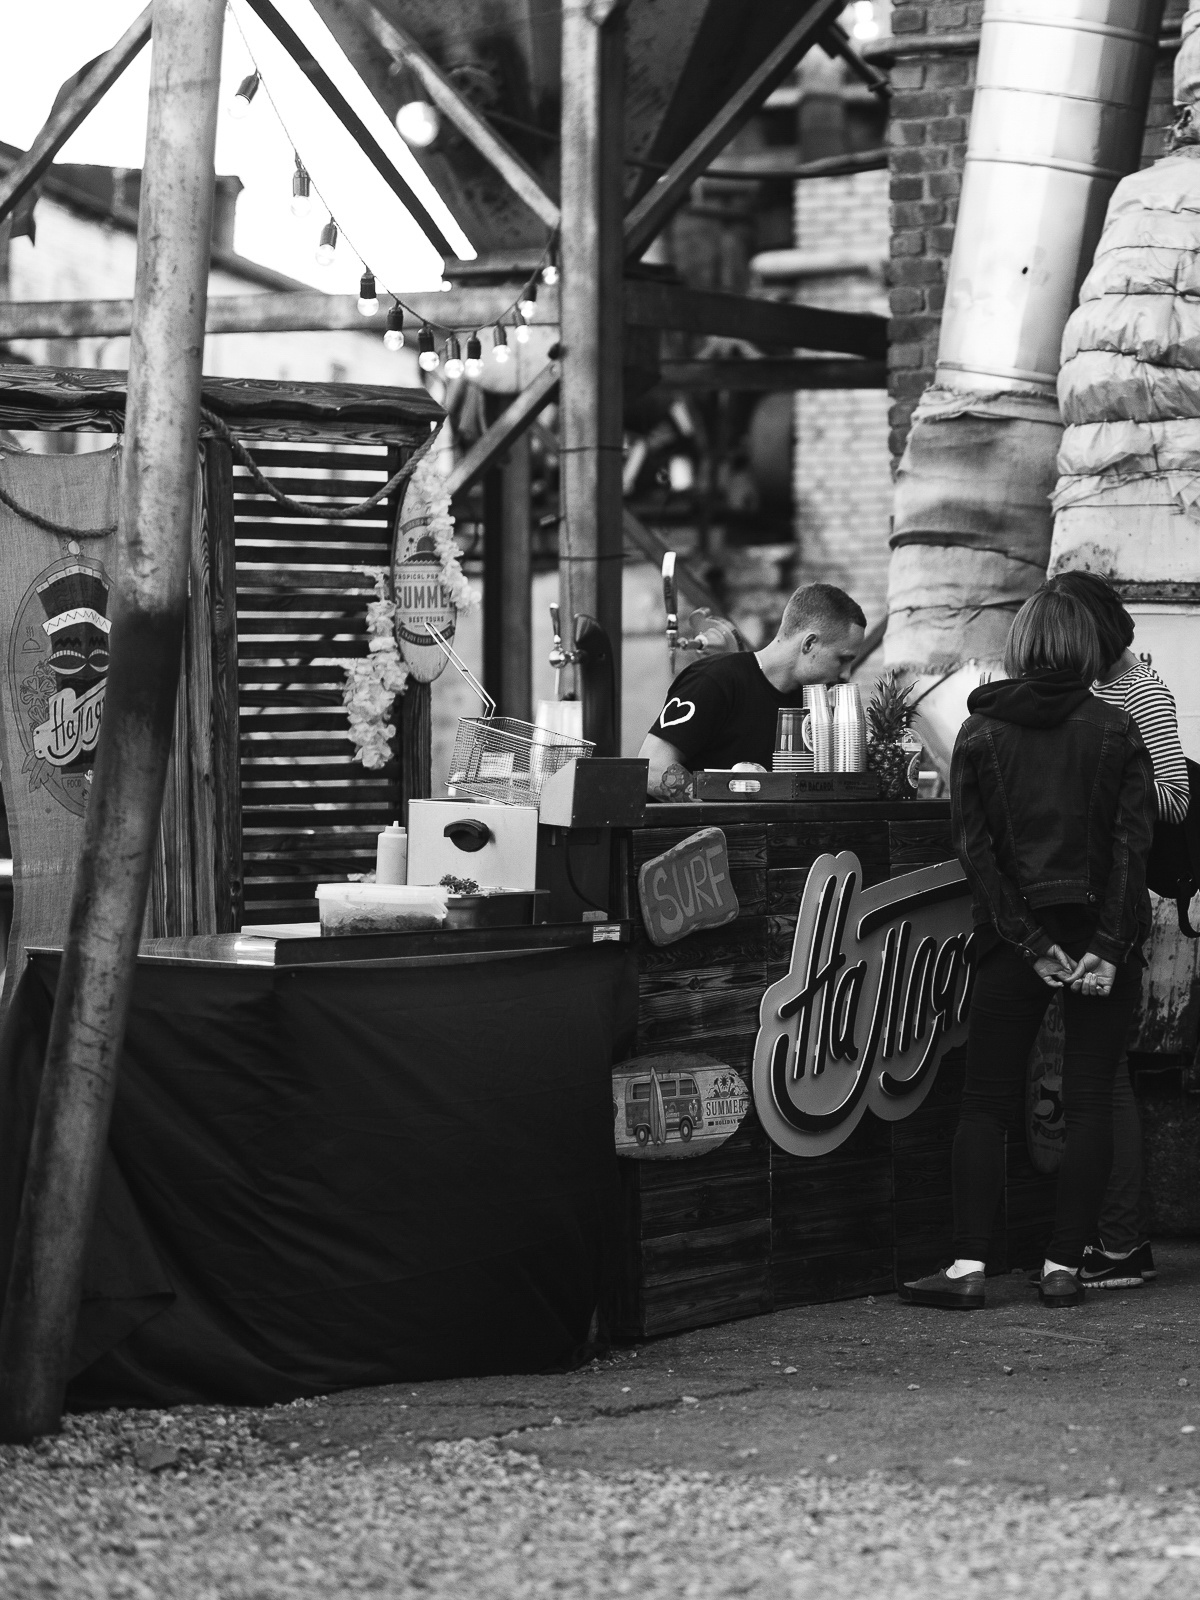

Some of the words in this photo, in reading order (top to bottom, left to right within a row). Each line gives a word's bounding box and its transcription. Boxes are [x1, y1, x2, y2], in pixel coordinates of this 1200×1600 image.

[66, 779, 82, 788] FOOD
[653, 845, 725, 934] SURF
[706, 1099, 744, 1116] SUMMER
